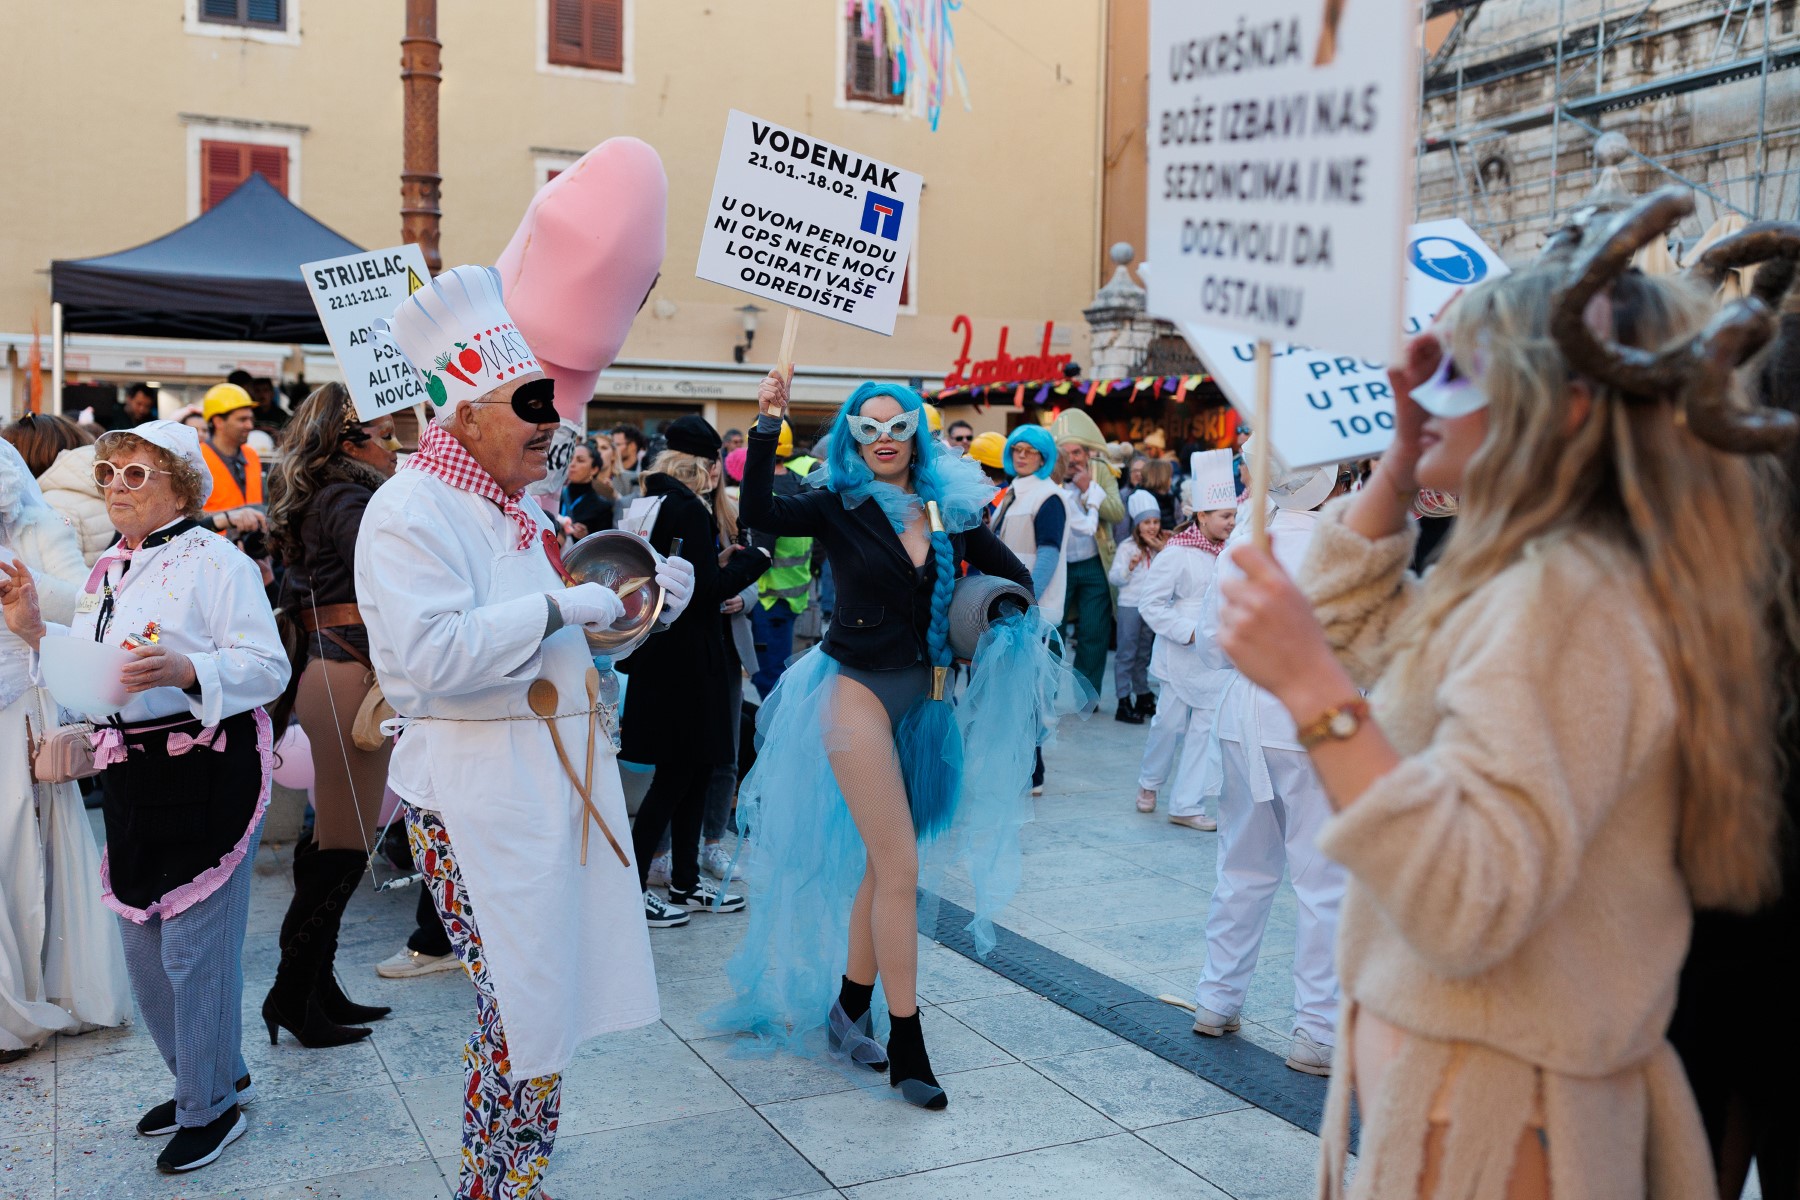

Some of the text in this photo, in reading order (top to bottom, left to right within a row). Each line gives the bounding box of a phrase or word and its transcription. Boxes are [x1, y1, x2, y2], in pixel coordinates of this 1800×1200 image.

[1169, 17, 1302, 83] USKRŠNJA
[1159, 83, 1379, 146] BOŽE IZBAVI NAS
[748, 152, 857, 199] 21.01.-18.02.
[751, 121, 900, 192] VODENJAK
[1307, 160, 1320, 202] I
[1323, 156, 1367, 203] NE
[714, 215, 895, 284] NI GPS NEĆE MOĆI
[721, 196, 897, 263] U OVOM PERIODU
[1182, 219, 1334, 269] DOZVOLI DA
[315, 255, 406, 290] STRIJELAC
[725, 240, 877, 299] LOCIRATI VAŠE
[740, 267, 856, 313] ODREDIŠTE
[329, 286, 392, 310] 22.11-21.12.
[1201, 276, 1304, 328] OSTANU
[370, 362, 415, 387] ALI TA
[375, 378, 427, 408] NOVČA
[1306, 382, 1394, 410] U TR
